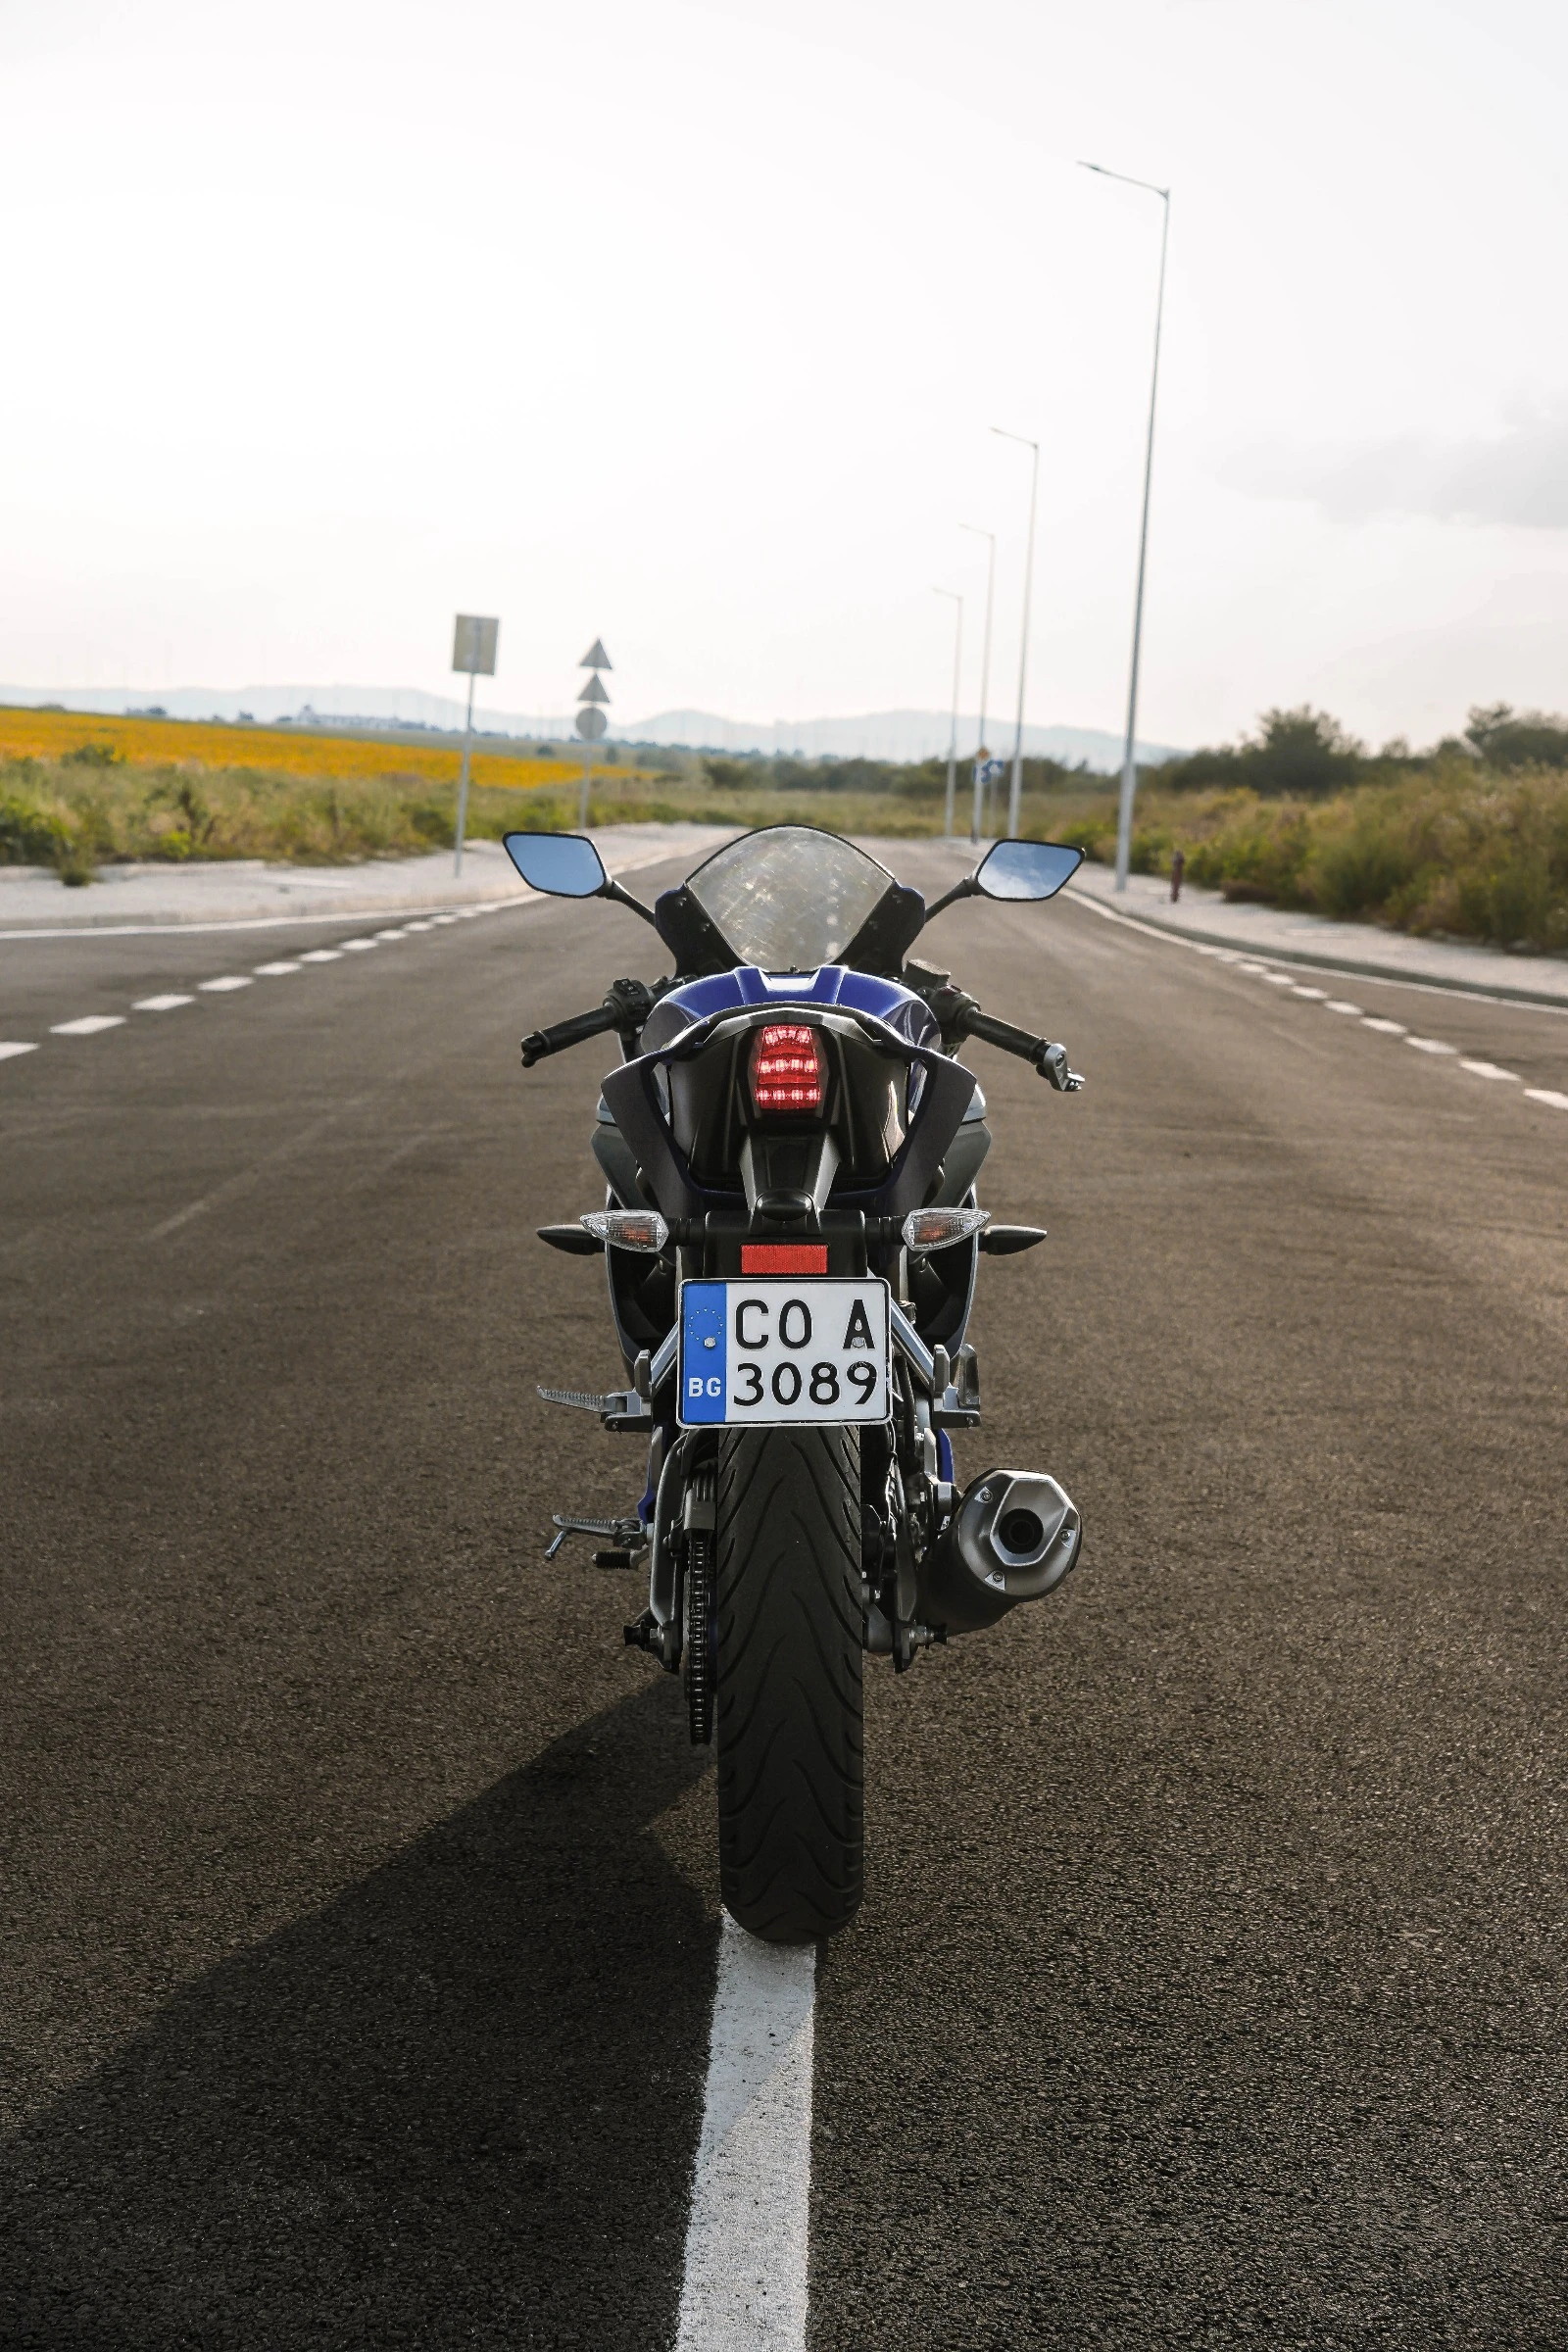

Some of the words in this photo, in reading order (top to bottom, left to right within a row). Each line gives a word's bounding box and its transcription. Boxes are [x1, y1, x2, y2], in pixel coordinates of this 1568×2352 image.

[735, 1298, 812, 1349] CO
[843, 1298, 875, 1349] A
[688, 1377, 721, 1397] BG
[734, 1361, 878, 1406] 3089
